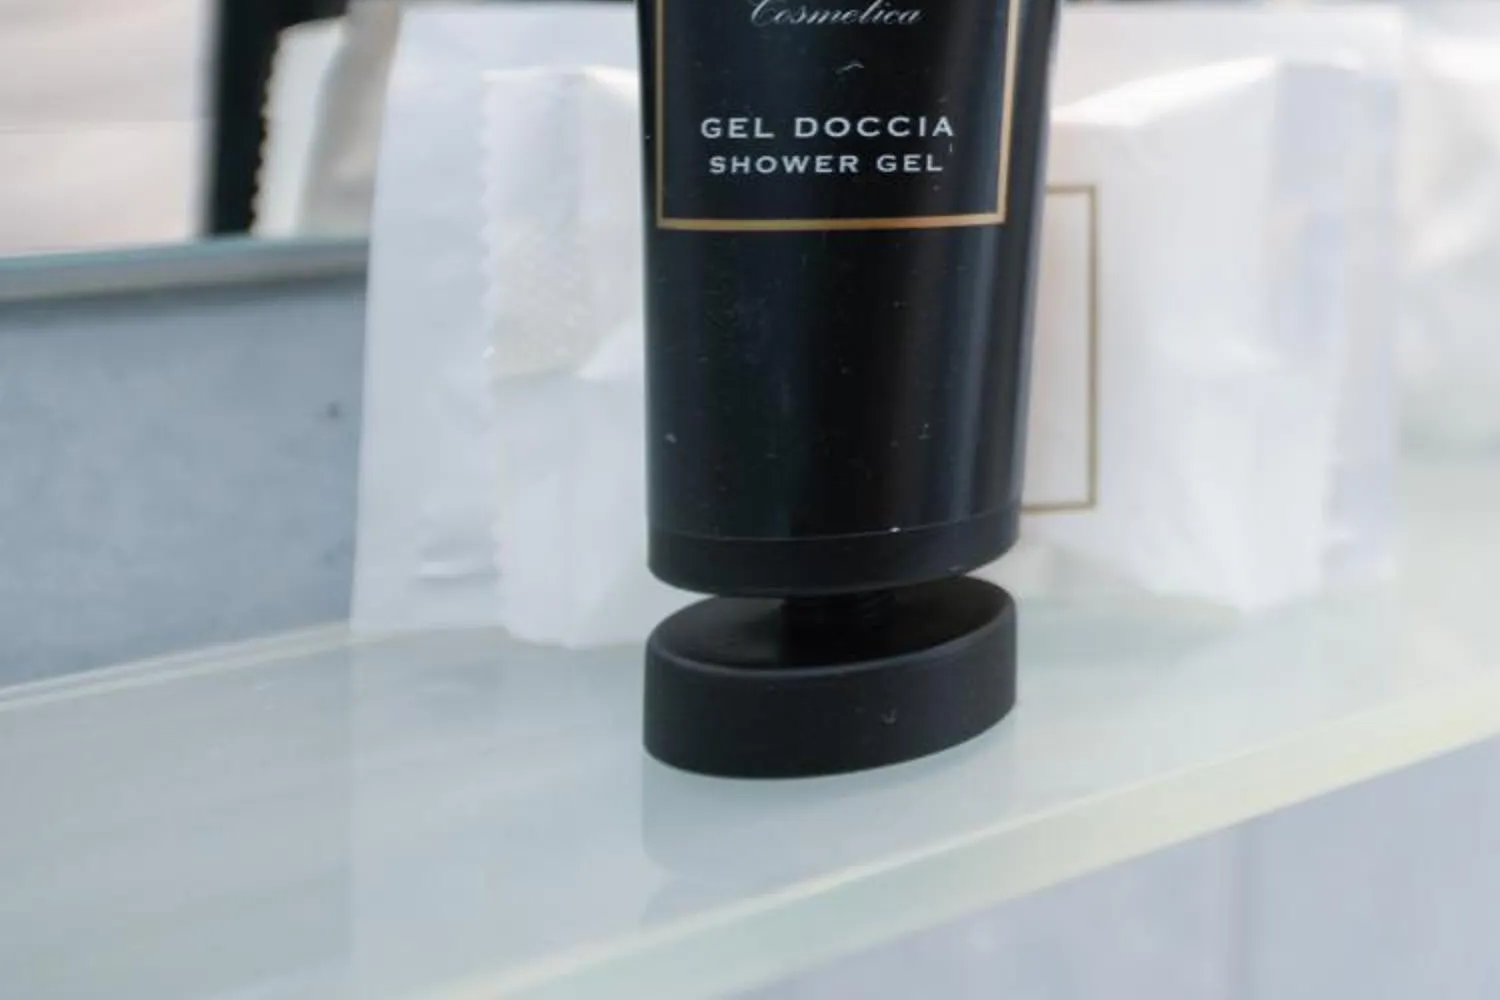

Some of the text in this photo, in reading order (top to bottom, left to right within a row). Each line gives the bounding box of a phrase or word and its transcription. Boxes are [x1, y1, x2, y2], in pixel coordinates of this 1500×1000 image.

[700, 116, 954, 139] GEL DOCCIA
[709, 153, 944, 174] SHOWER GEL
